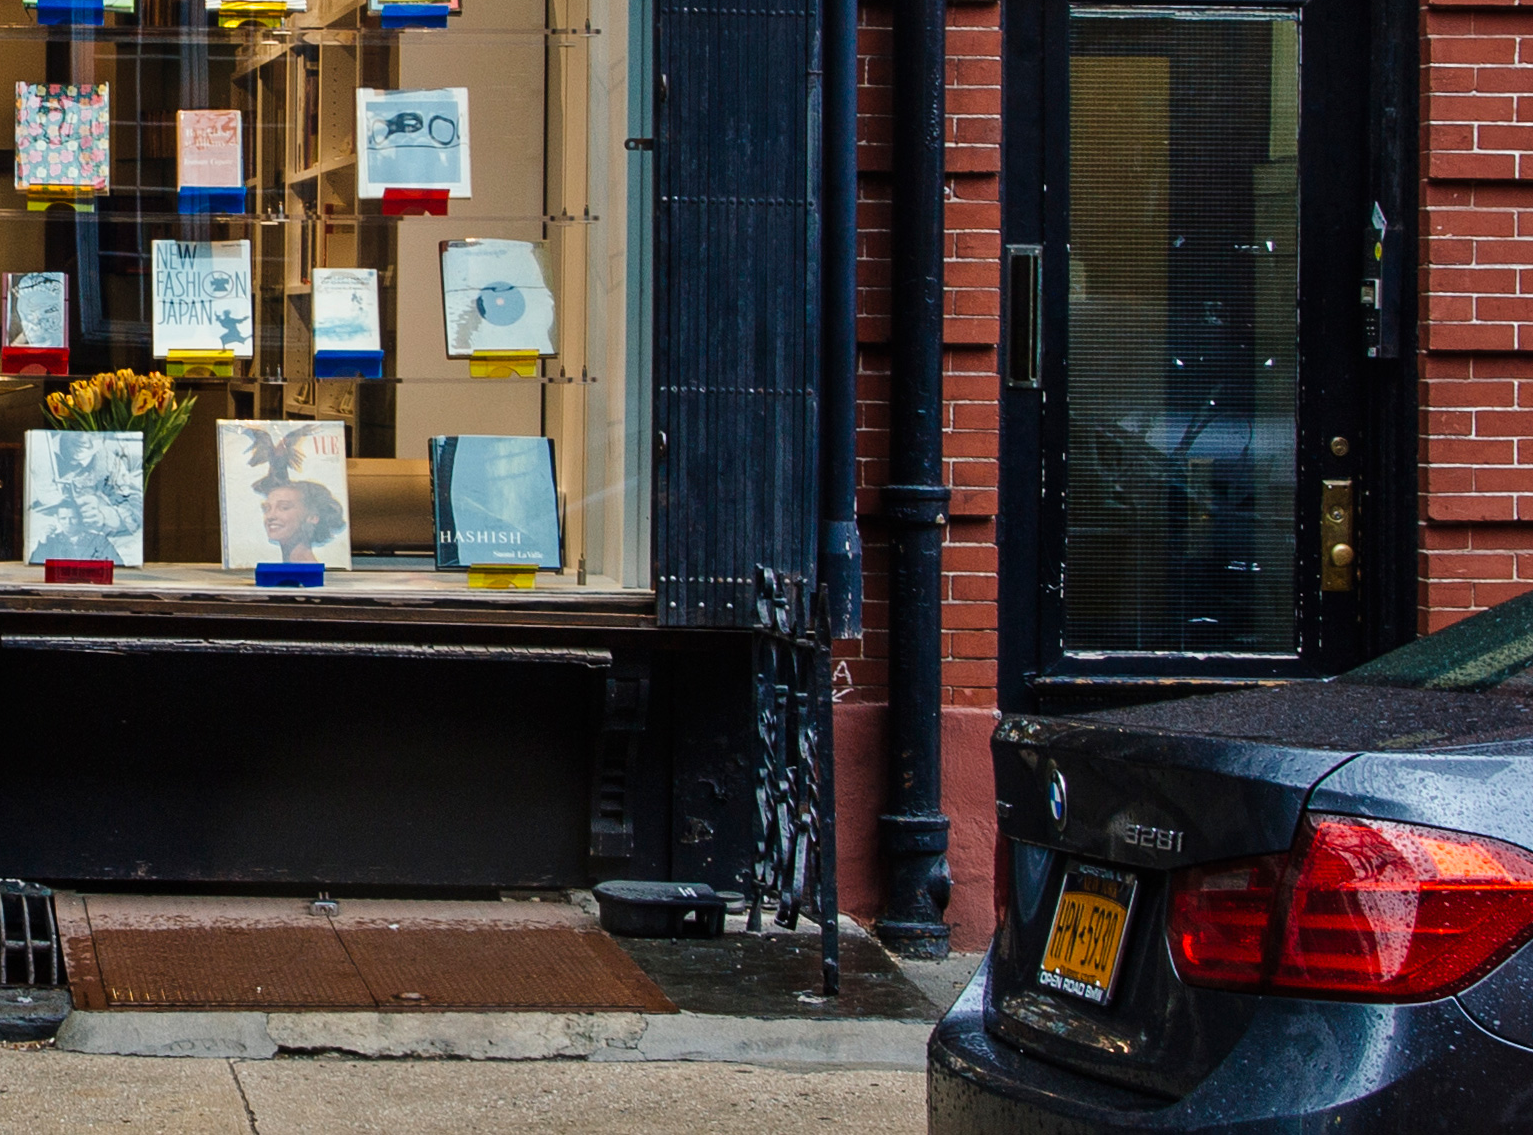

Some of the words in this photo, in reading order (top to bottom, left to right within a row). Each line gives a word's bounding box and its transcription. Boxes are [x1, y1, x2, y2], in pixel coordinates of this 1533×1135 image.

[156, 242, 197, 270] NEW
[156, 270, 247, 299] FASHION
[157, 299, 213, 326] JAPAN
[313, 435, 340, 456] VUE
[439, 530, 522, 545] HASHISH
[832, 660, 854, 686] A
[1039, 969, 1064, 989] OPEN
[1062, 976, 1085, 997] ROAD
[1084, 983, 1105, 1003] BMW
